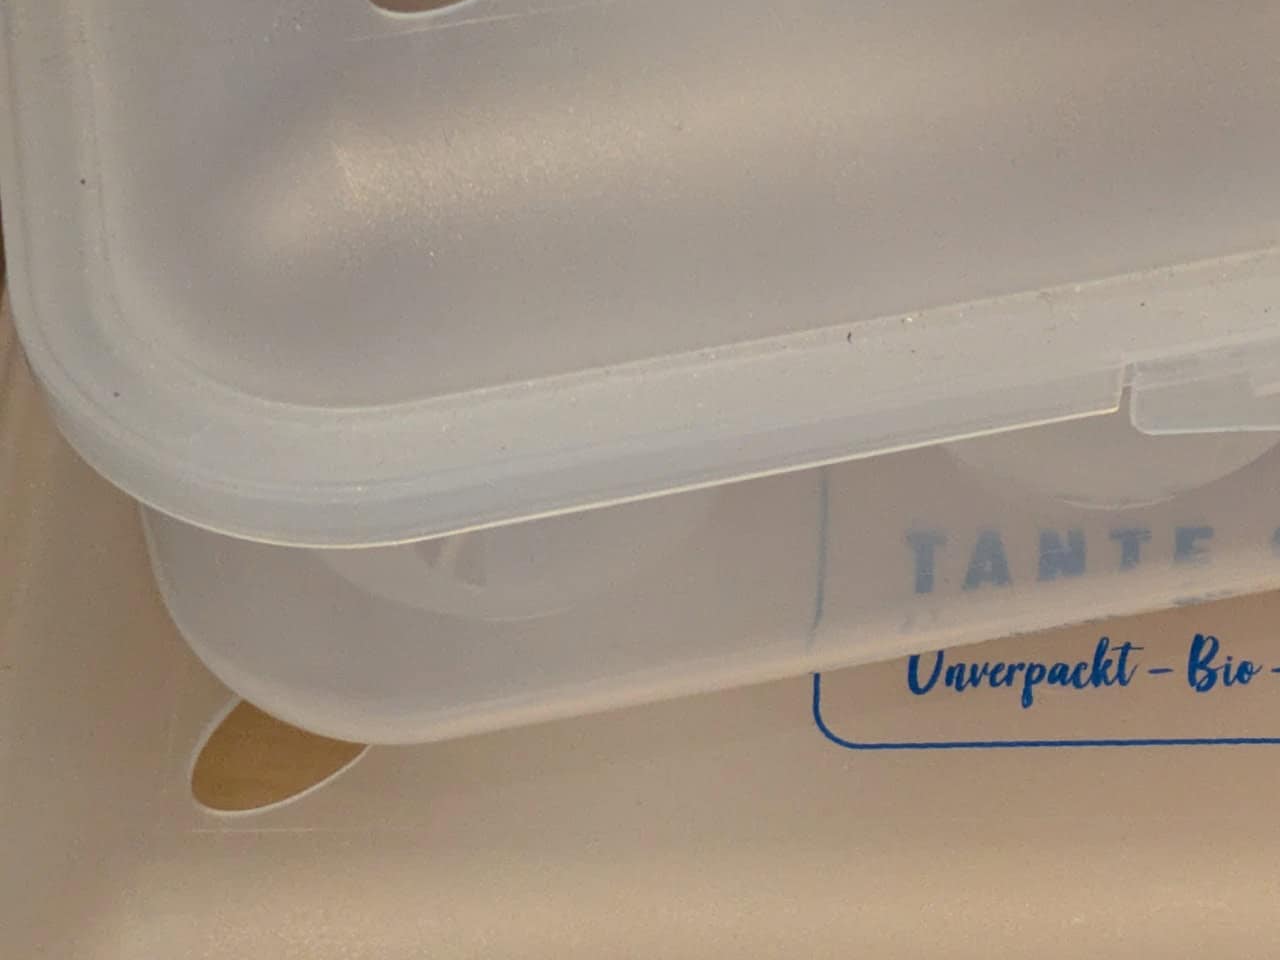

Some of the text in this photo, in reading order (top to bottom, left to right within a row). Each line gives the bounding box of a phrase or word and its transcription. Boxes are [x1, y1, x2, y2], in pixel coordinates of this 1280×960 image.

[905, 525, 1215, 594] TANTE
[907, 636, 1145, 709] Unverpackt
[1187, 633, 1263, 693] Bio
